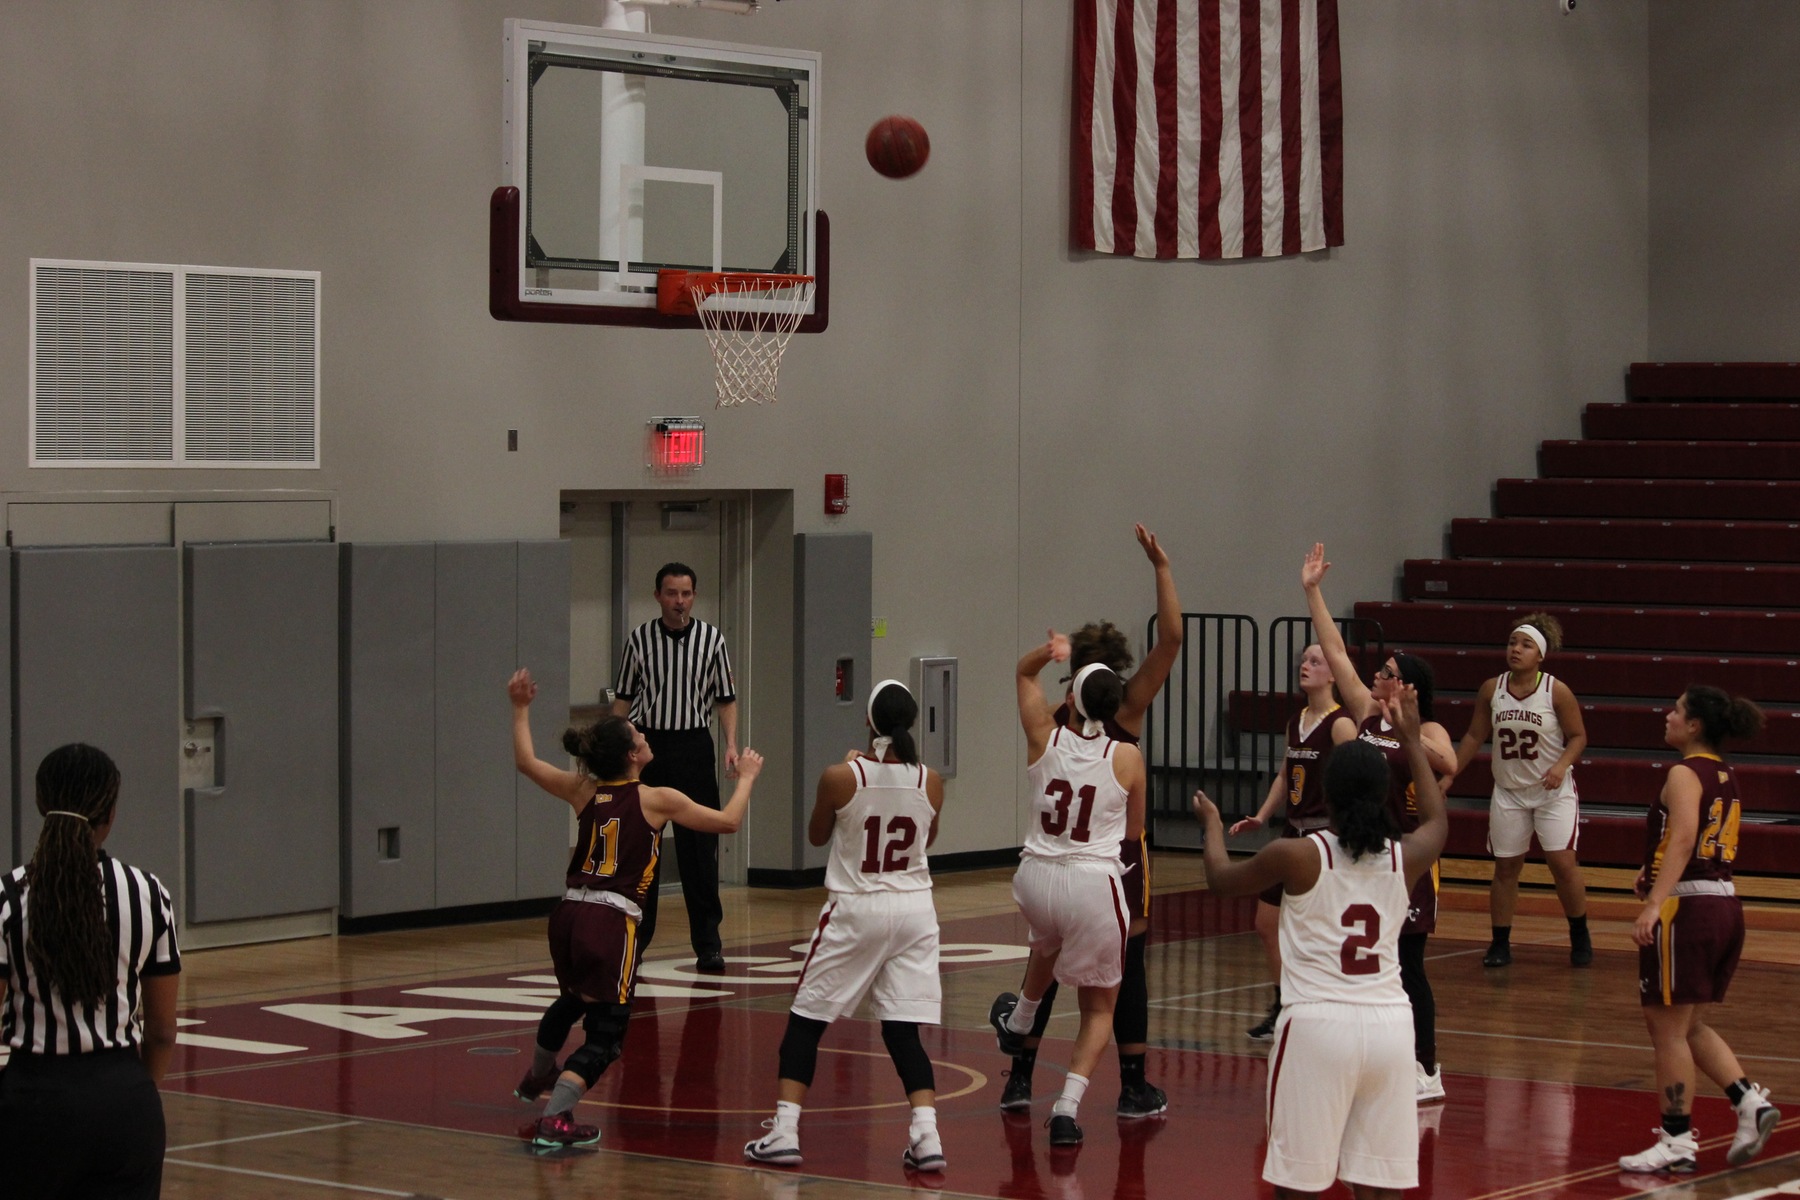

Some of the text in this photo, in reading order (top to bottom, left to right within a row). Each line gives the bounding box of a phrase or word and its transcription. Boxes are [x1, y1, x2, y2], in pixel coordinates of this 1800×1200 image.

[1495, 709, 1543, 727] MUSTANGS
[1498, 728, 1539, 761] 22
[1041, 778, 1097, 843] 31
[1290, 764, 1306, 806] 3
[581, 817, 621, 877] 11
[861, 815, 917, 874] 12
[1697, 797, 1741, 863] 24
[1341, 903, 1381, 975] 2
